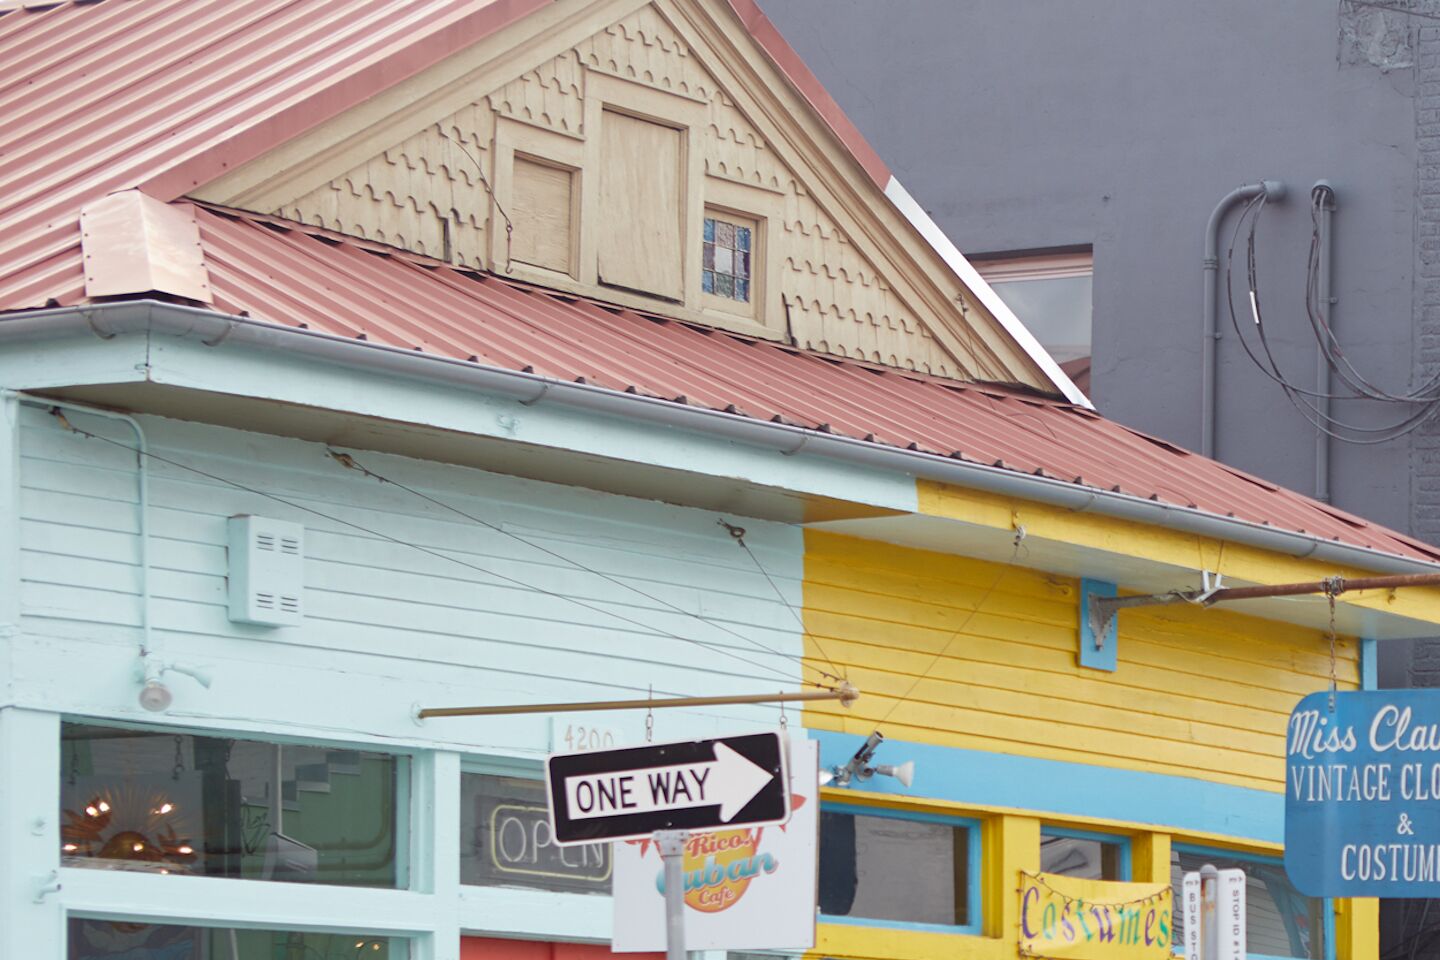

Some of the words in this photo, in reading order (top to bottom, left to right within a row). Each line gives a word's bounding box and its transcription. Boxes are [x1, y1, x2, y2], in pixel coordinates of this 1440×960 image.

[1289, 709, 1357, 760] Miss
[576, 776, 637, 814] ONE
[648, 767, 711, 806] WAY
[1291, 763, 1391, 802] VINTAGE
[1397, 812, 1414, 835] &
[1021, 886, 1169, 948] Costumes
[1189, 892, 1197, 925] BUS
[1232, 889, 1240, 921] STOP
[1232, 924, 1240, 936] ID
